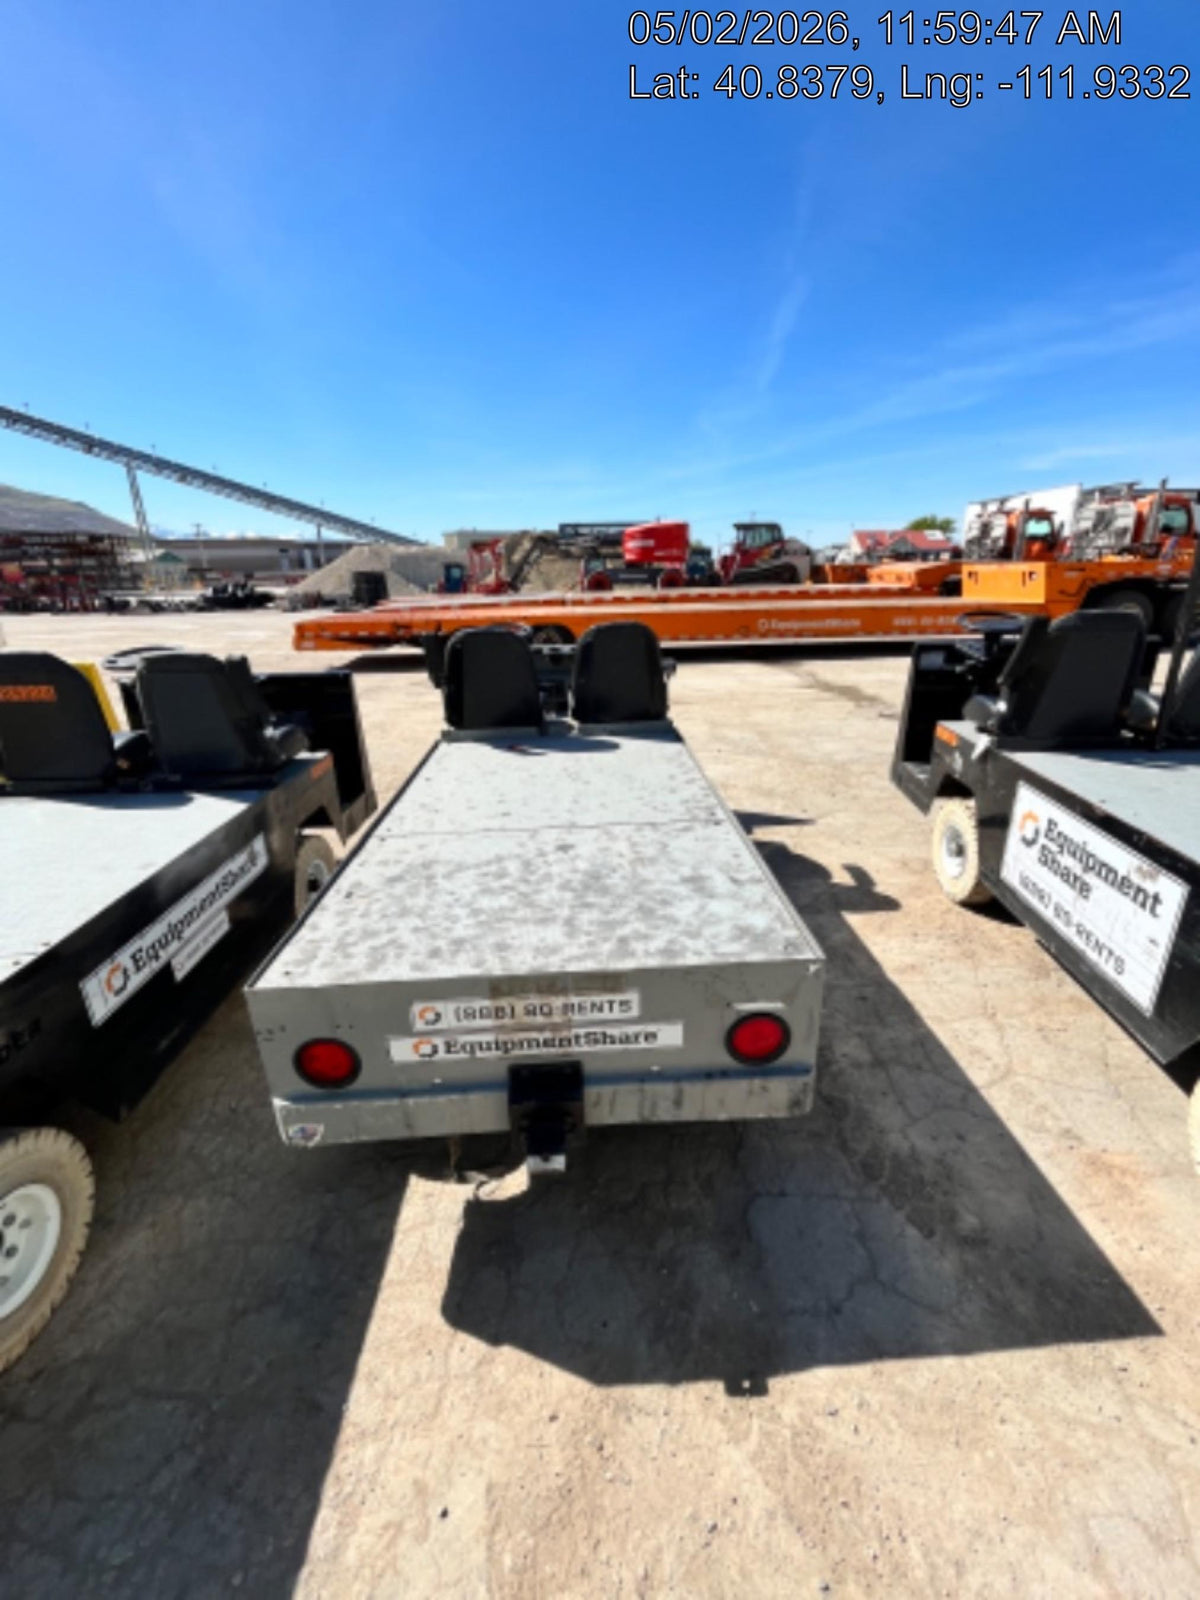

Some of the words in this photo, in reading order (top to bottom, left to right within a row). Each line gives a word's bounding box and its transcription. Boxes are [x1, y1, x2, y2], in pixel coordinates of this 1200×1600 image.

[1037, 843, 1093, 901] Share
[1044, 817, 1164, 918] Equipment
[444, 1030, 659, 1057] EquipmentShare
